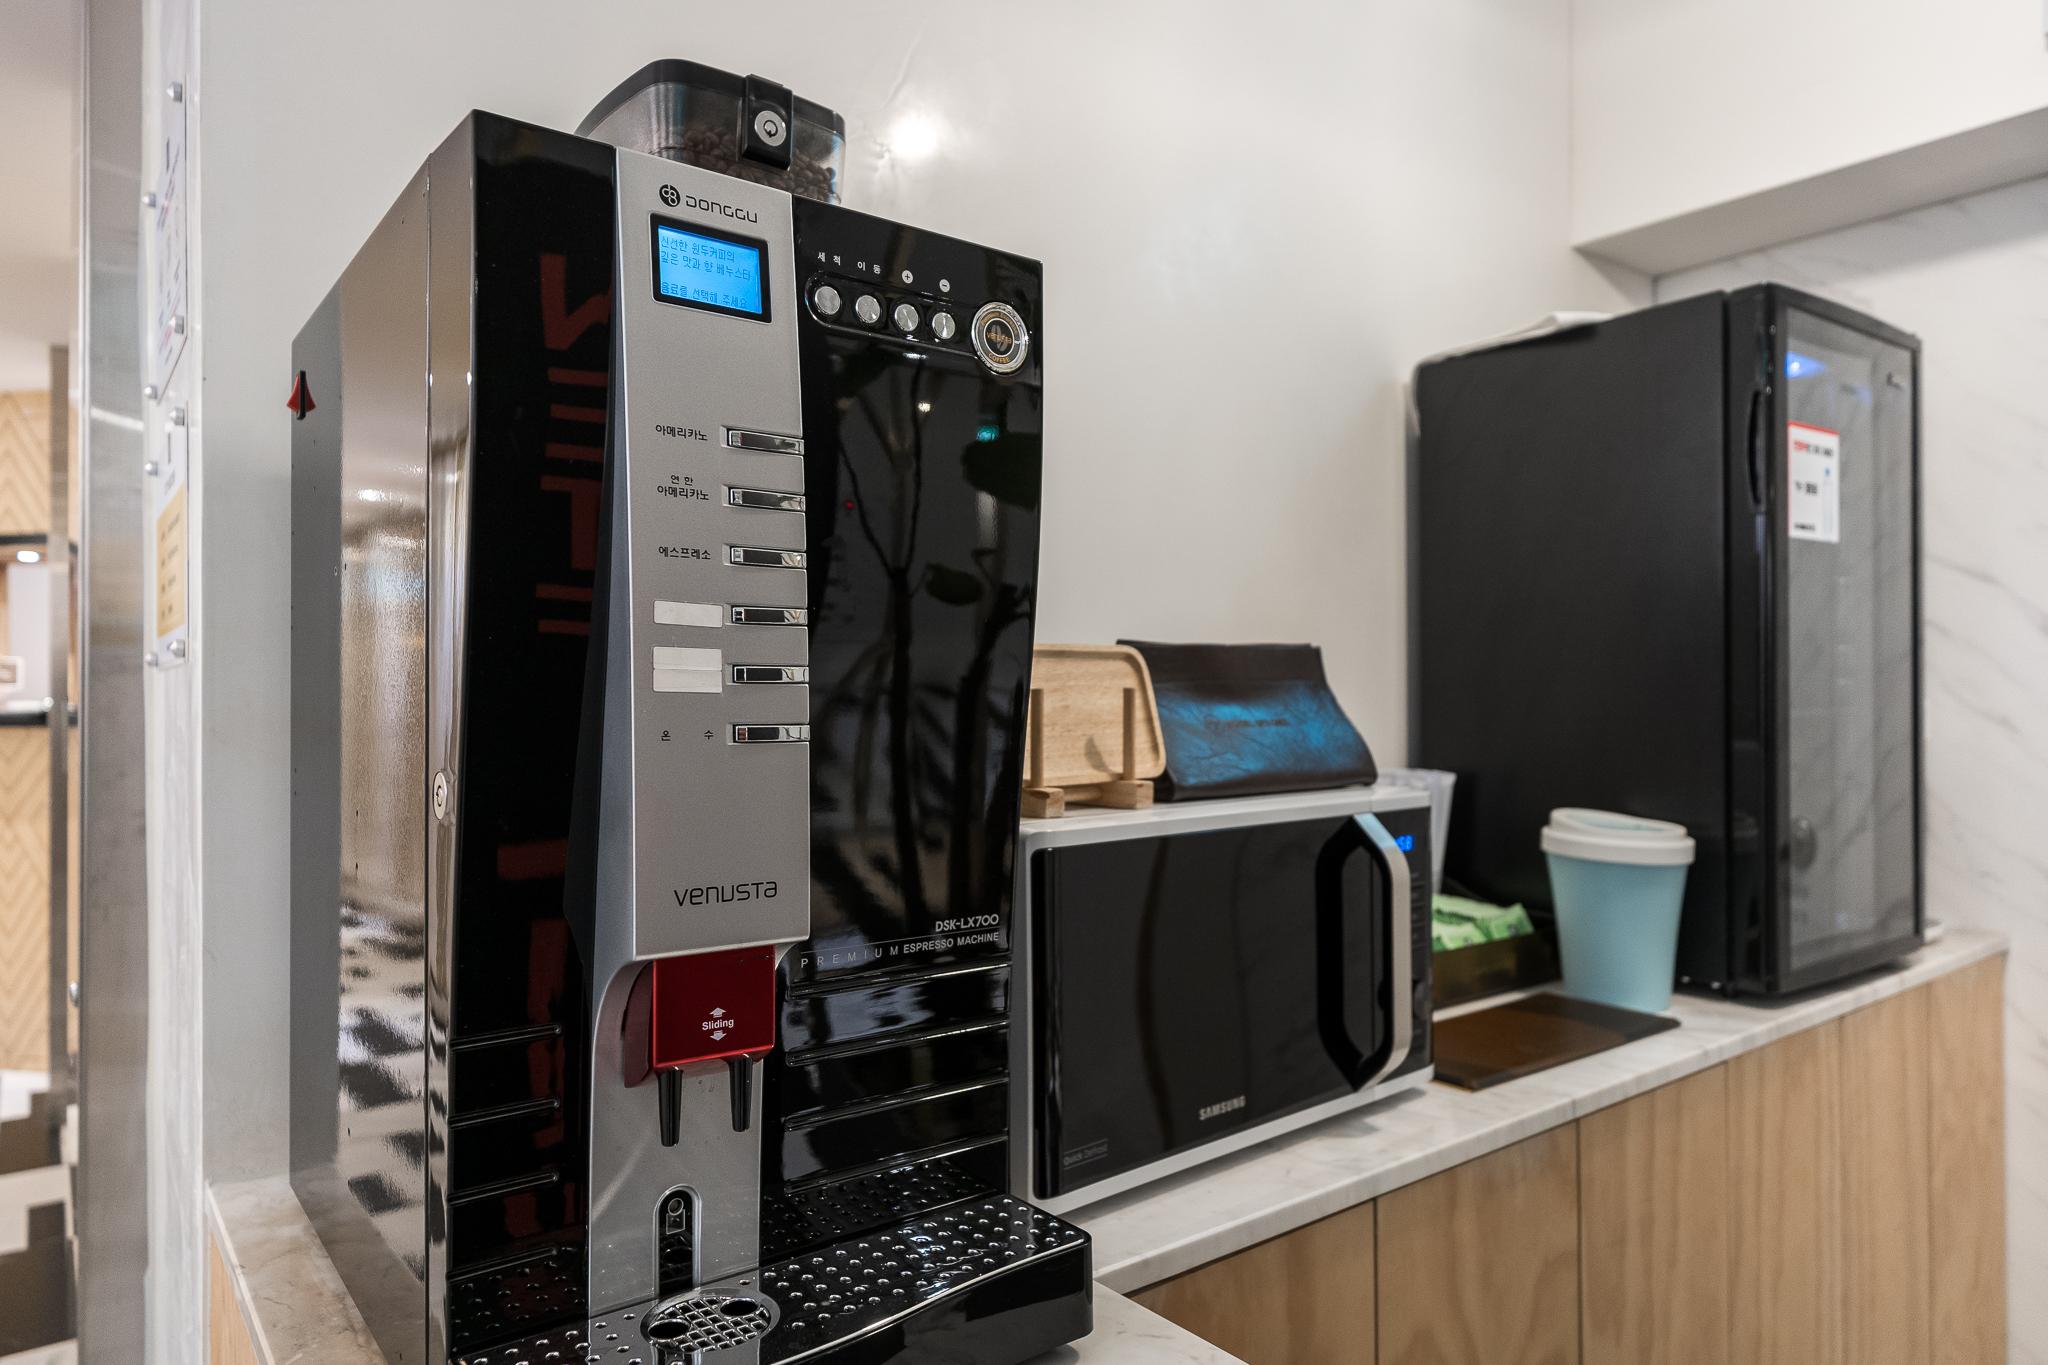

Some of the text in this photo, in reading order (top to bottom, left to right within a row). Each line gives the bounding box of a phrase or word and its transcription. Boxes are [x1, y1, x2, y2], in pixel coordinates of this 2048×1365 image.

[661, 236, 688, 252] 신선한
[683, 255, 701, 270] 맛과
[988, 353, 1009, 364] COFFEE
[655, 424, 708, 441] 아메리카노
[656, 485, 710, 501] 아메리카노
[658, 546, 711, 560] 에스프레소
[935, 913, 1000, 932] DSK-LX700
[800, 931, 1000, 969] PREMIUM ESPRESSO MACHINE
[702, 1019, 735, 1031] Sliding
[1199, 1095, 1247, 1121] SAMSUNG
